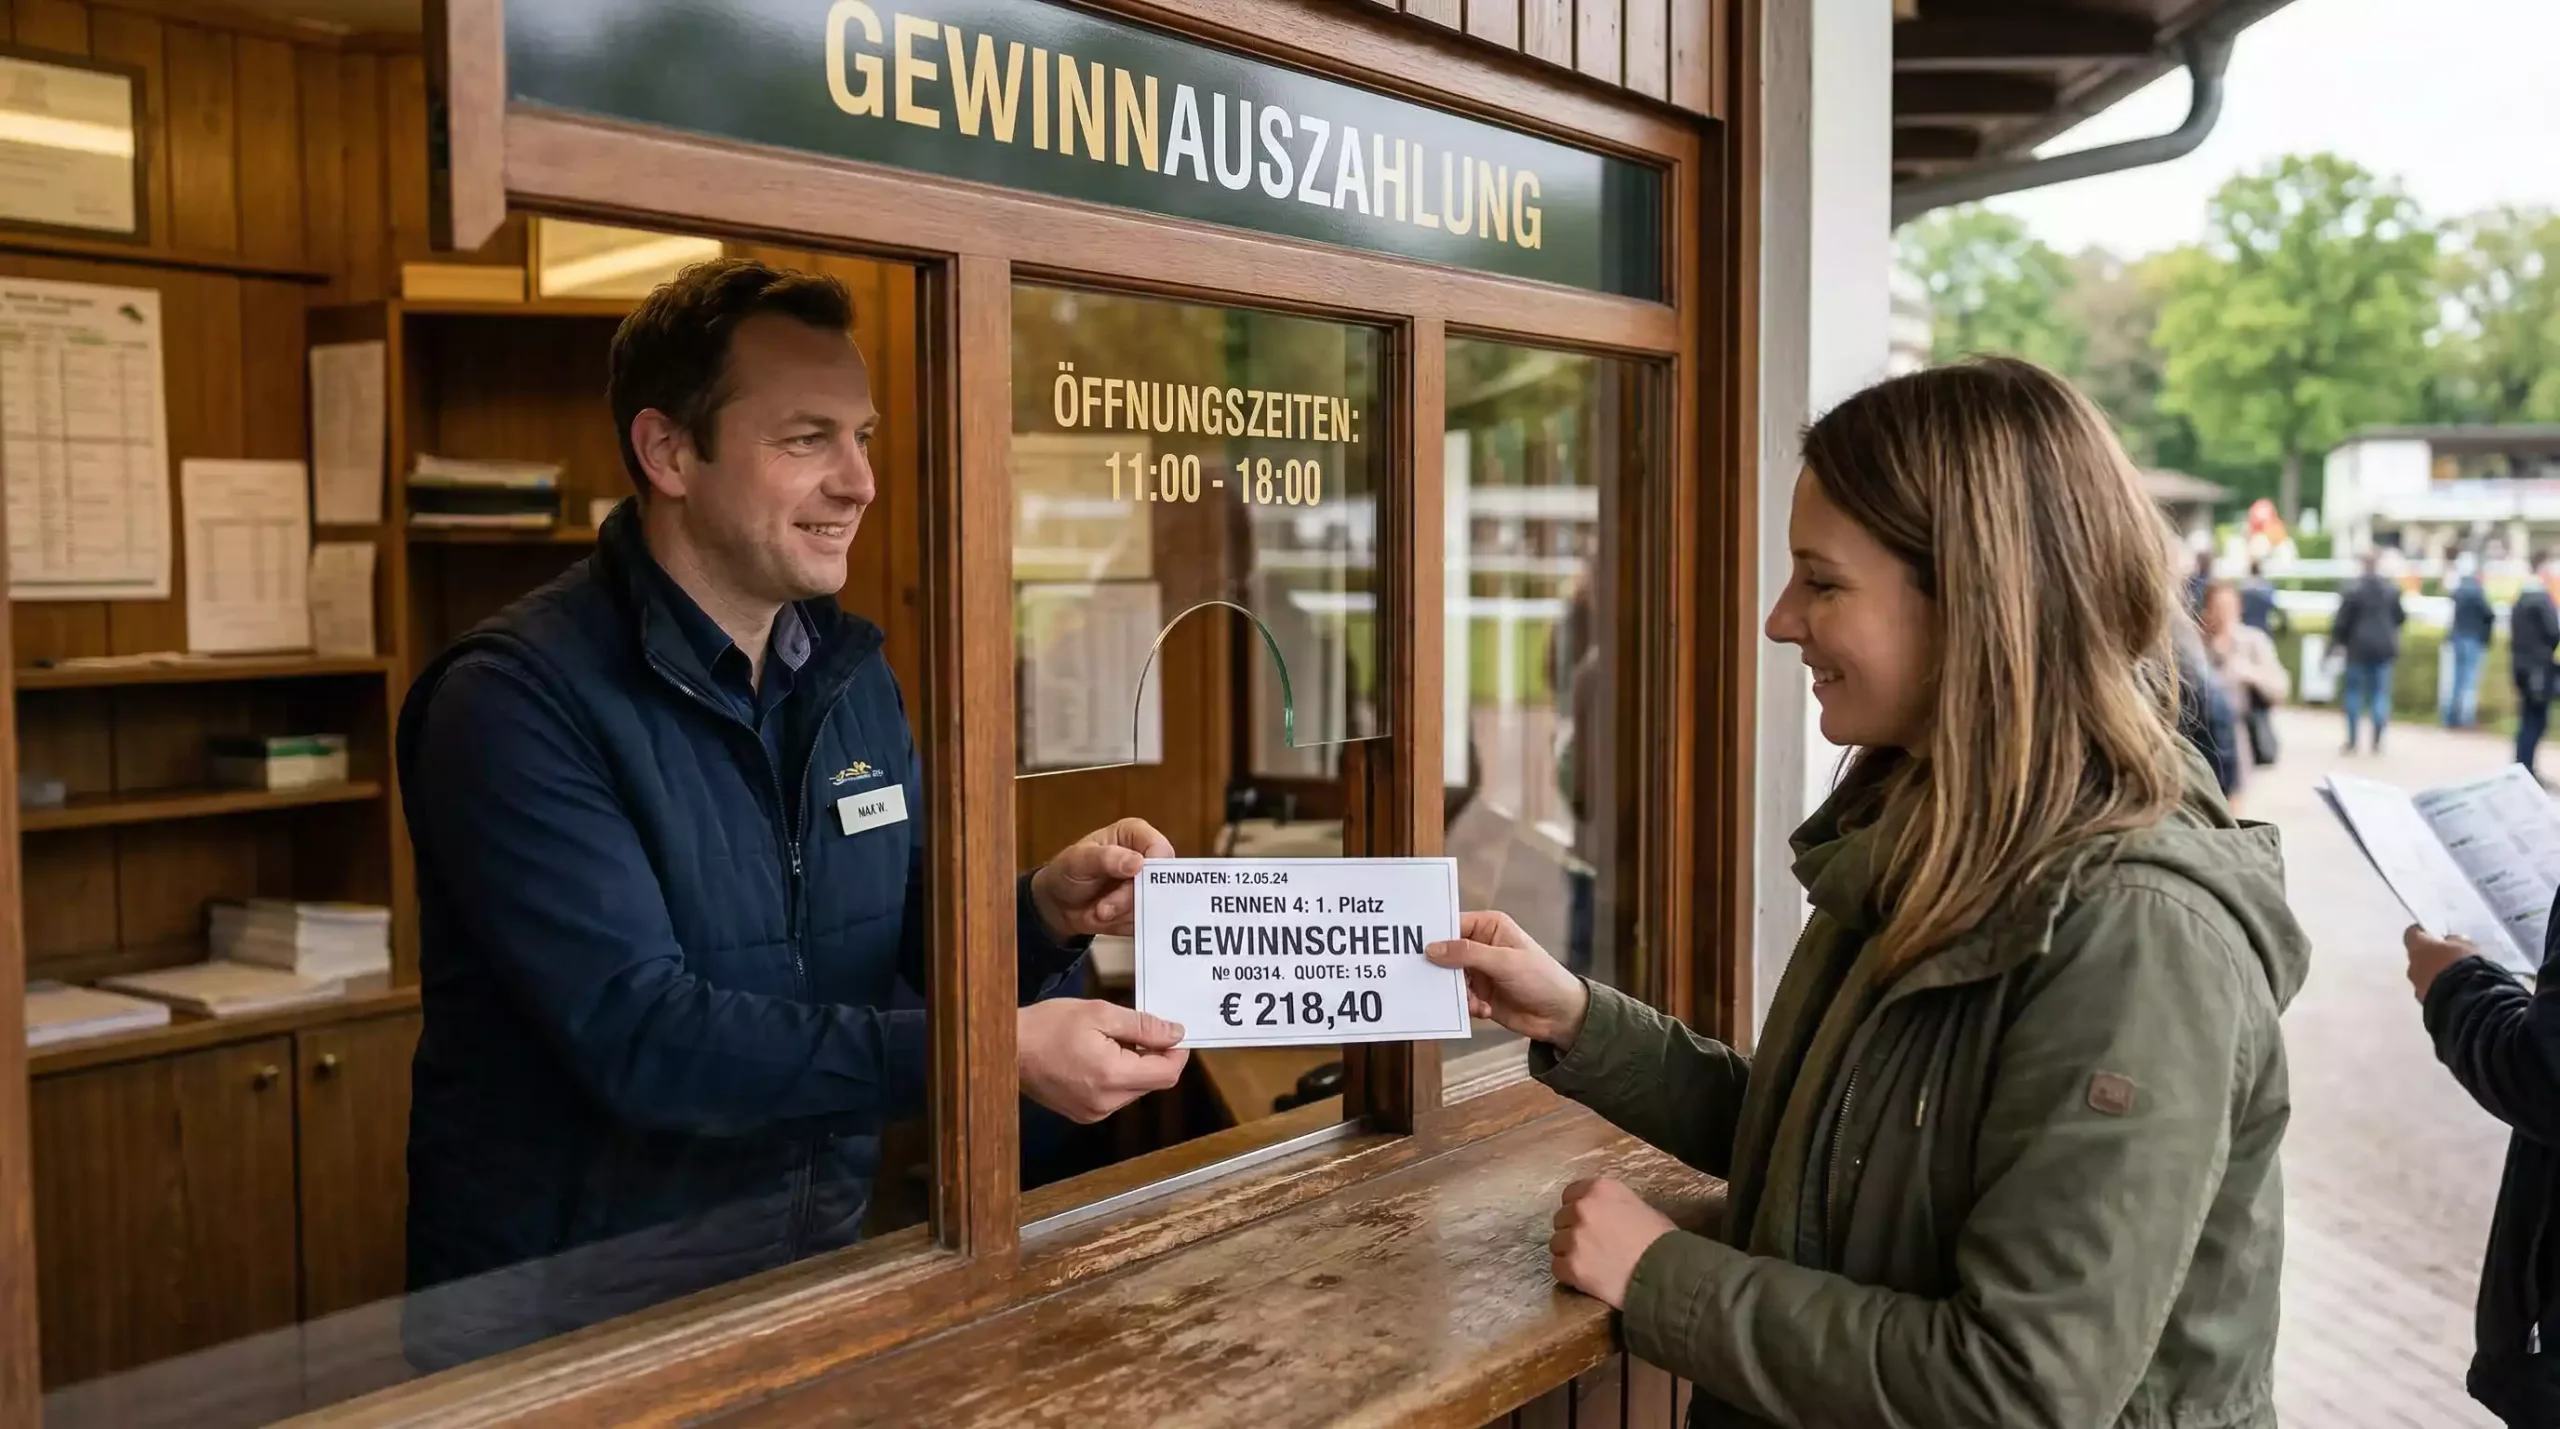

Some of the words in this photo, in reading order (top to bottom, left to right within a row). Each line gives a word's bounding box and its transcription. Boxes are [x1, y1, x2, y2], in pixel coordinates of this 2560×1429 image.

[825, 0, 1542, 250] GEWINNAUSZAHLUNG
[1054, 361, 1359, 443] ÖFFNUNGSZEITEN:
[1105, 452, 1201, 503] 11:00
[1212, 479, 1224, 488] -
[1236, 457, 1321, 506] 18:00
[1150, 871, 1231, 885] RENNDATEN:
[1235, 872, 1289, 885] 12.05.24
[1211, 896, 1286, 914] RENNEN
[1292, 896, 1309, 914] 4:
[1316, 896, 1332, 914] 1.
[1339, 896, 1384, 914] Platz
[1171, 925, 1424, 956] GEWINNSCHEIN
[1234, 965, 1285, 981] 00314.
[1294, 964, 1350, 981] QUOTE:
[1354, 964, 1387, 980] 15.6
[1219, 992, 1243, 1027] €
[1254, 990, 1383, 1030] 218,40
